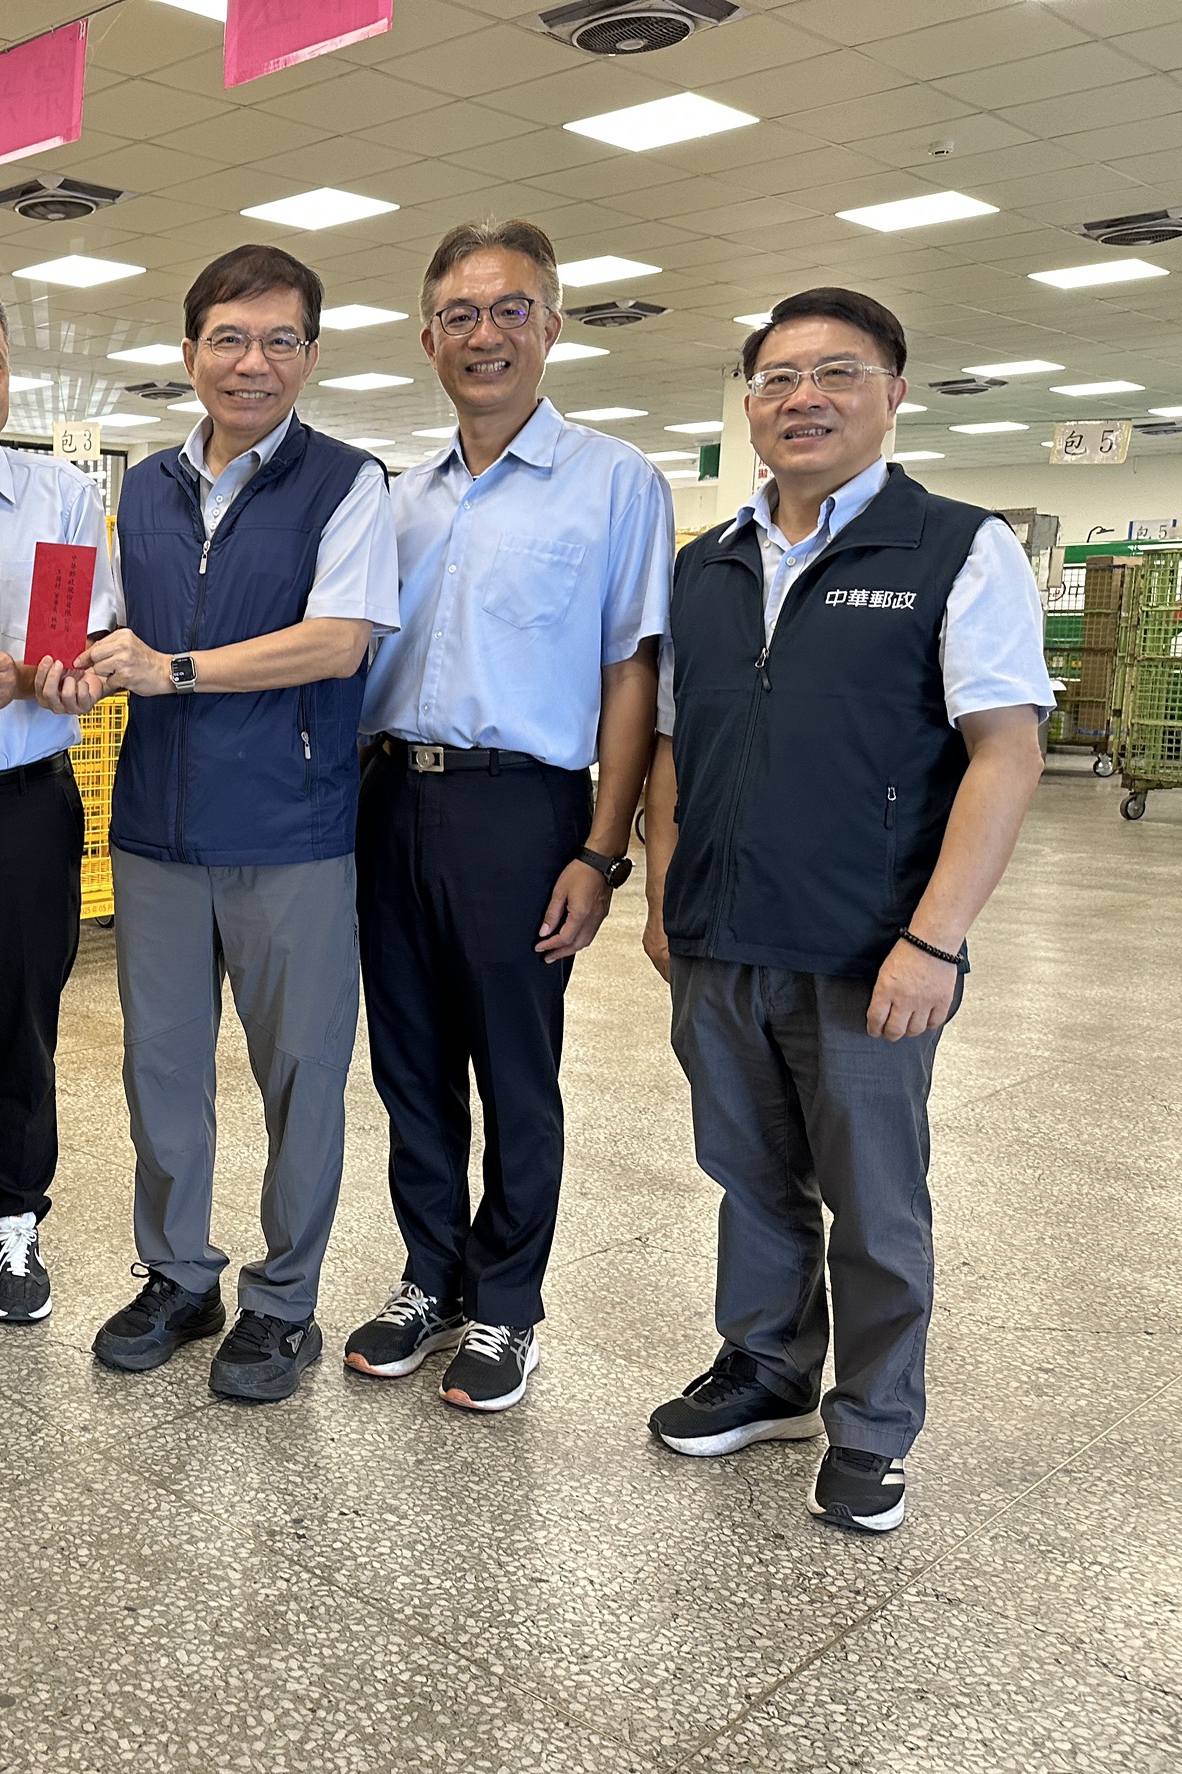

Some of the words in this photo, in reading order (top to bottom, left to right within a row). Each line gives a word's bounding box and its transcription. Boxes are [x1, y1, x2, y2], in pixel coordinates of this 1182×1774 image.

[62, 430, 77, 453] 包
[84, 430, 92, 451] 3
[1064, 430, 1087, 455] 包
[1099, 430, 1114, 453] 5
[1158, 525, 1167, 539] 5
[825, 589, 917, 610] 中華郵政
[99, 904, 107, 912] 05
